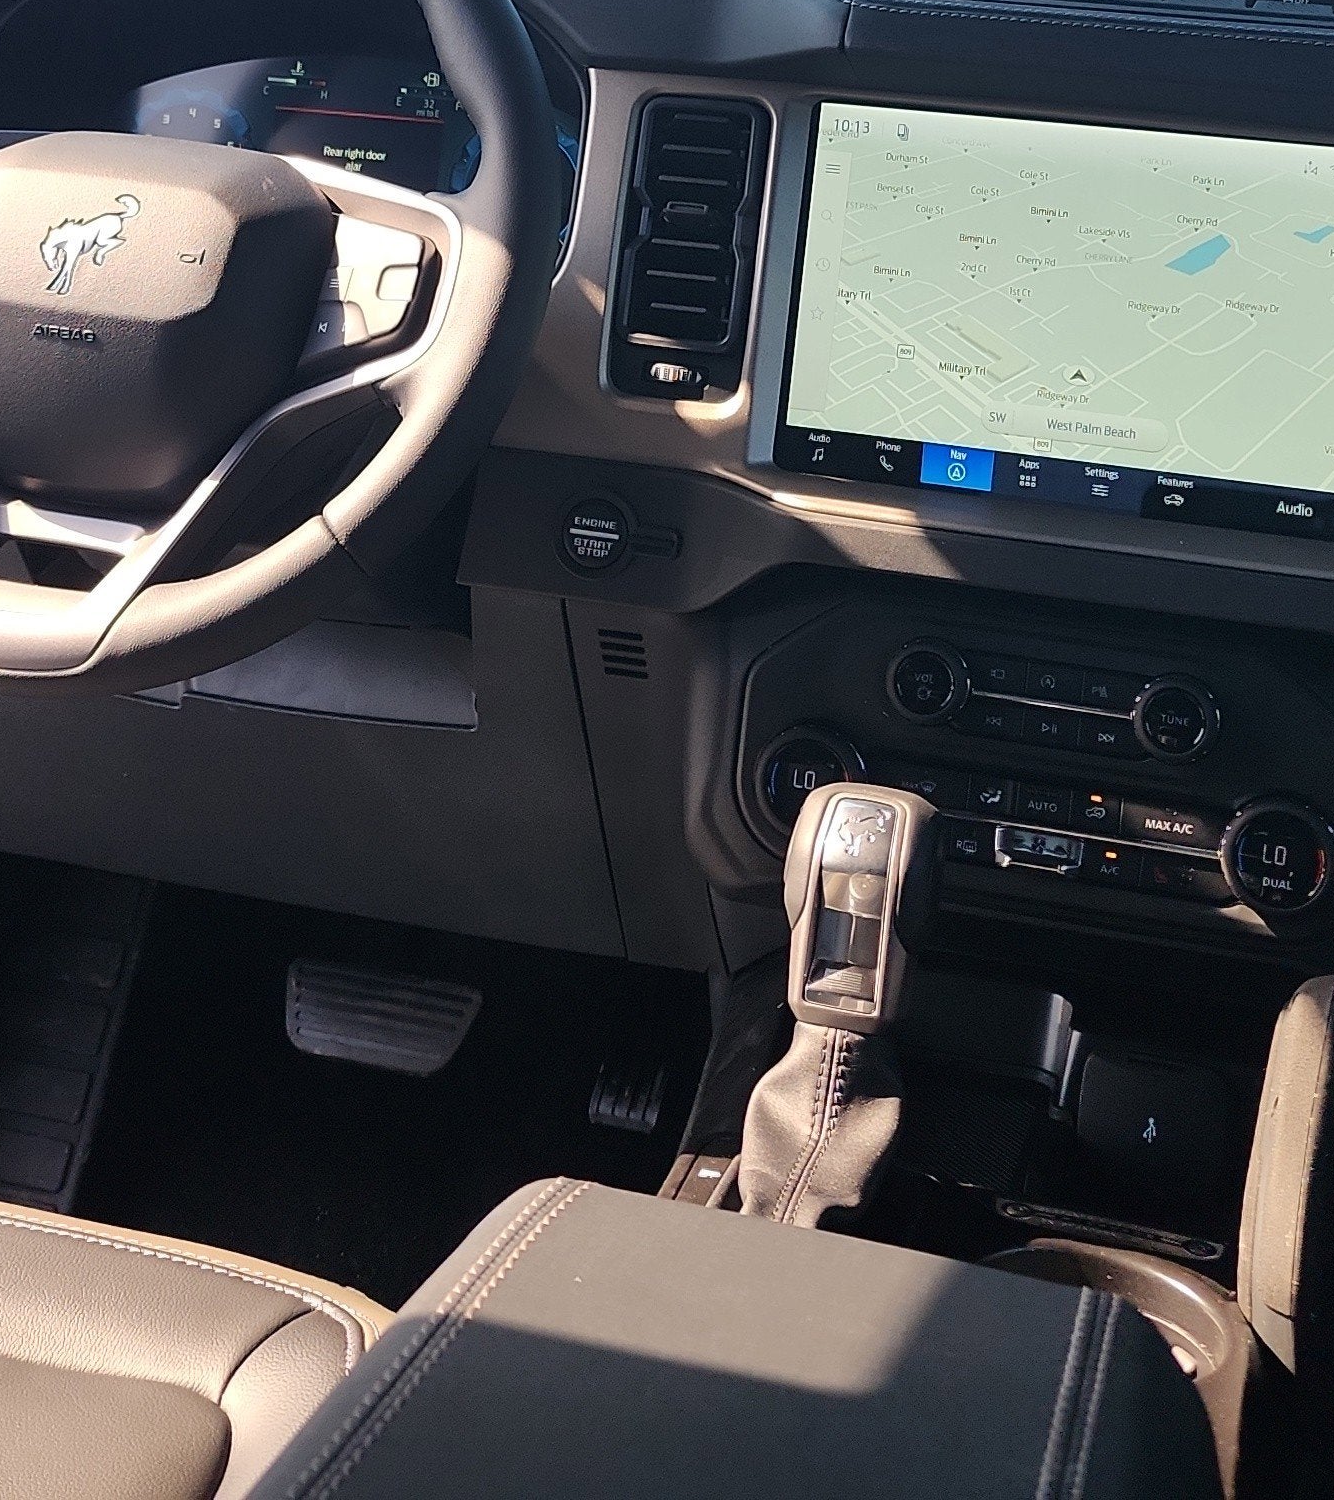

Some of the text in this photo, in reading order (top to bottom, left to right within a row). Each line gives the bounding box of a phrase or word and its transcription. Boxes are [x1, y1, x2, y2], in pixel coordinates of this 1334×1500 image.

[395, 96, 403, 107] E
[423, 98, 435, 109] 32
[162, 114, 170, 125] 3
[189, 108, 197, 118] 4
[213, 118, 221, 129] 5
[834, 118, 871, 134] 10:13
[323, 145, 387, 161] Rear right door
[885, 152, 929, 164] Durham St
[345, 161, 362, 172] ajar
[1019, 169, 1049, 181] Cole St
[1192, 175, 1225, 186] Park Ln
[905, 184, 914, 195] St
[970, 185, 999, 197] Cole St
[915, 204, 944, 216] Cole St
[1030, 206, 1069, 218] Bimini Ln
[1176, 214, 1218, 227] Cherry Rd
[1079, 225, 1116, 237] Lakeside
[959, 233, 997, 245] Bimini Ln
[960, 262, 987, 273] 2nd Ct
[1016, 254, 1056, 268] Cherry Rd
[873, 265, 911, 277] Bimini Ln
[859, 290, 871, 301] Trl
[1021, 288, 1031, 298] Ct
[1128, 300, 1181, 314] Ridgeway Dr
[1225, 299, 1280, 313] Ridgeway Dr
[31, 323, 96, 342] AIRBAG
[938, 361, 987, 376] Military Trl
[1036, 389, 1090, 404] Ridgeway Dr
[988, 410, 1007, 424] SW
[1046, 418, 1137, 439] West Palm Beach
[808, 432, 831, 443] Audio
[875, 440, 902, 453] Phone
[950, 448, 968, 461] Nav
[1018, 458, 1040, 470] Apps
[1084, 466, 1120, 480] Settings
[1157, 475, 1194, 489] Features
[1275, 500, 1314, 518] Audio
[574, 516, 617, 530] ENGINE
[573, 537, 614, 550] START
[577, 546, 609, 558] STOP
[1161, 713, 1190, 727] TUNE
[1027, 799, 1058, 813] AUTO
[1144, 818, 1195, 836] MAX A/C
[1099, 864, 1120, 877] A/C
[1262, 876, 1294, 891] DUAL
